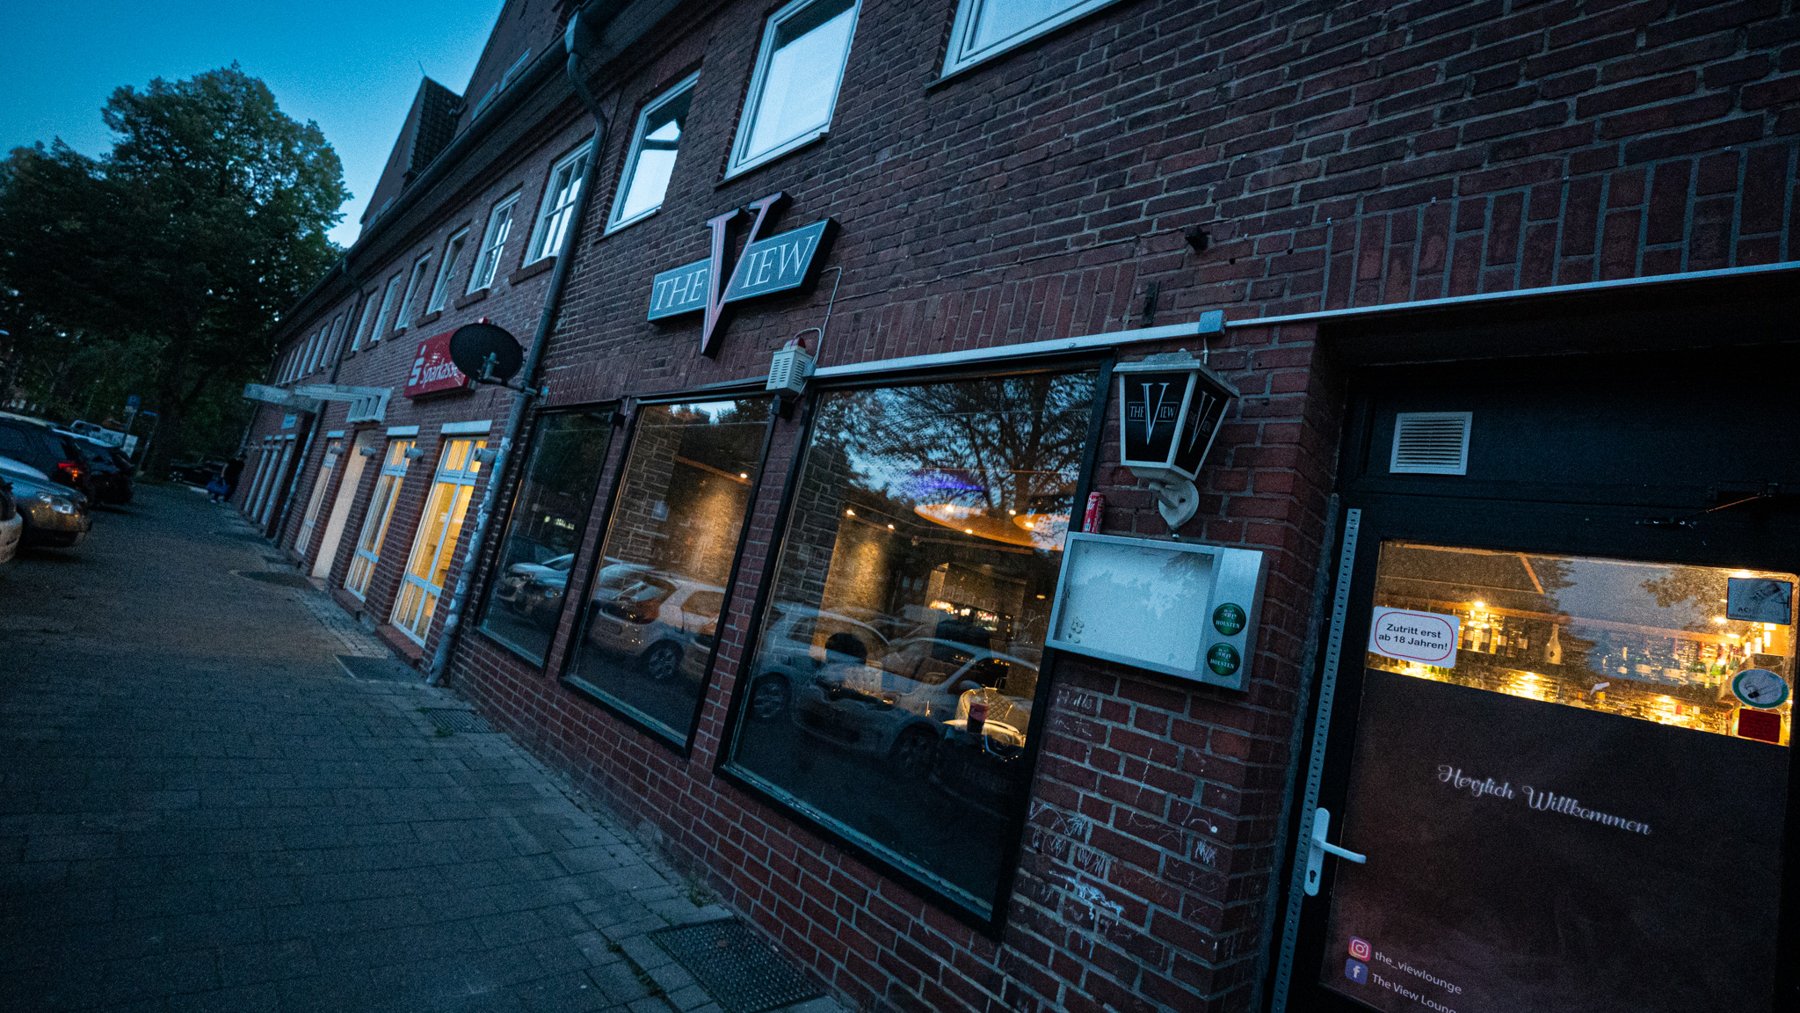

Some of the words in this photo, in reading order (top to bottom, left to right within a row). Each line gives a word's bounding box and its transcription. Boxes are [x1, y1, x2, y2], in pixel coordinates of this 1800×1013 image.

[654, 268, 708, 311] THE
[1130, 405, 1145, 418] THE
[1378, 633, 1391, 641] ab
[1394, 635, 1406, 643] 18
[1407, 637, 1448, 651] Jahren!
[1386, 623, 1419, 635] Zutritt
[1420, 628, 1441, 639] erst
[1437, 764, 1515, 800] Herzlich
[1522, 785, 1652, 836] Willkommen
[1372, 973, 1392, 989] The
[1393, 982, 1419, 1001] View
[1375, 951, 1462, 995] the_viewlounge
